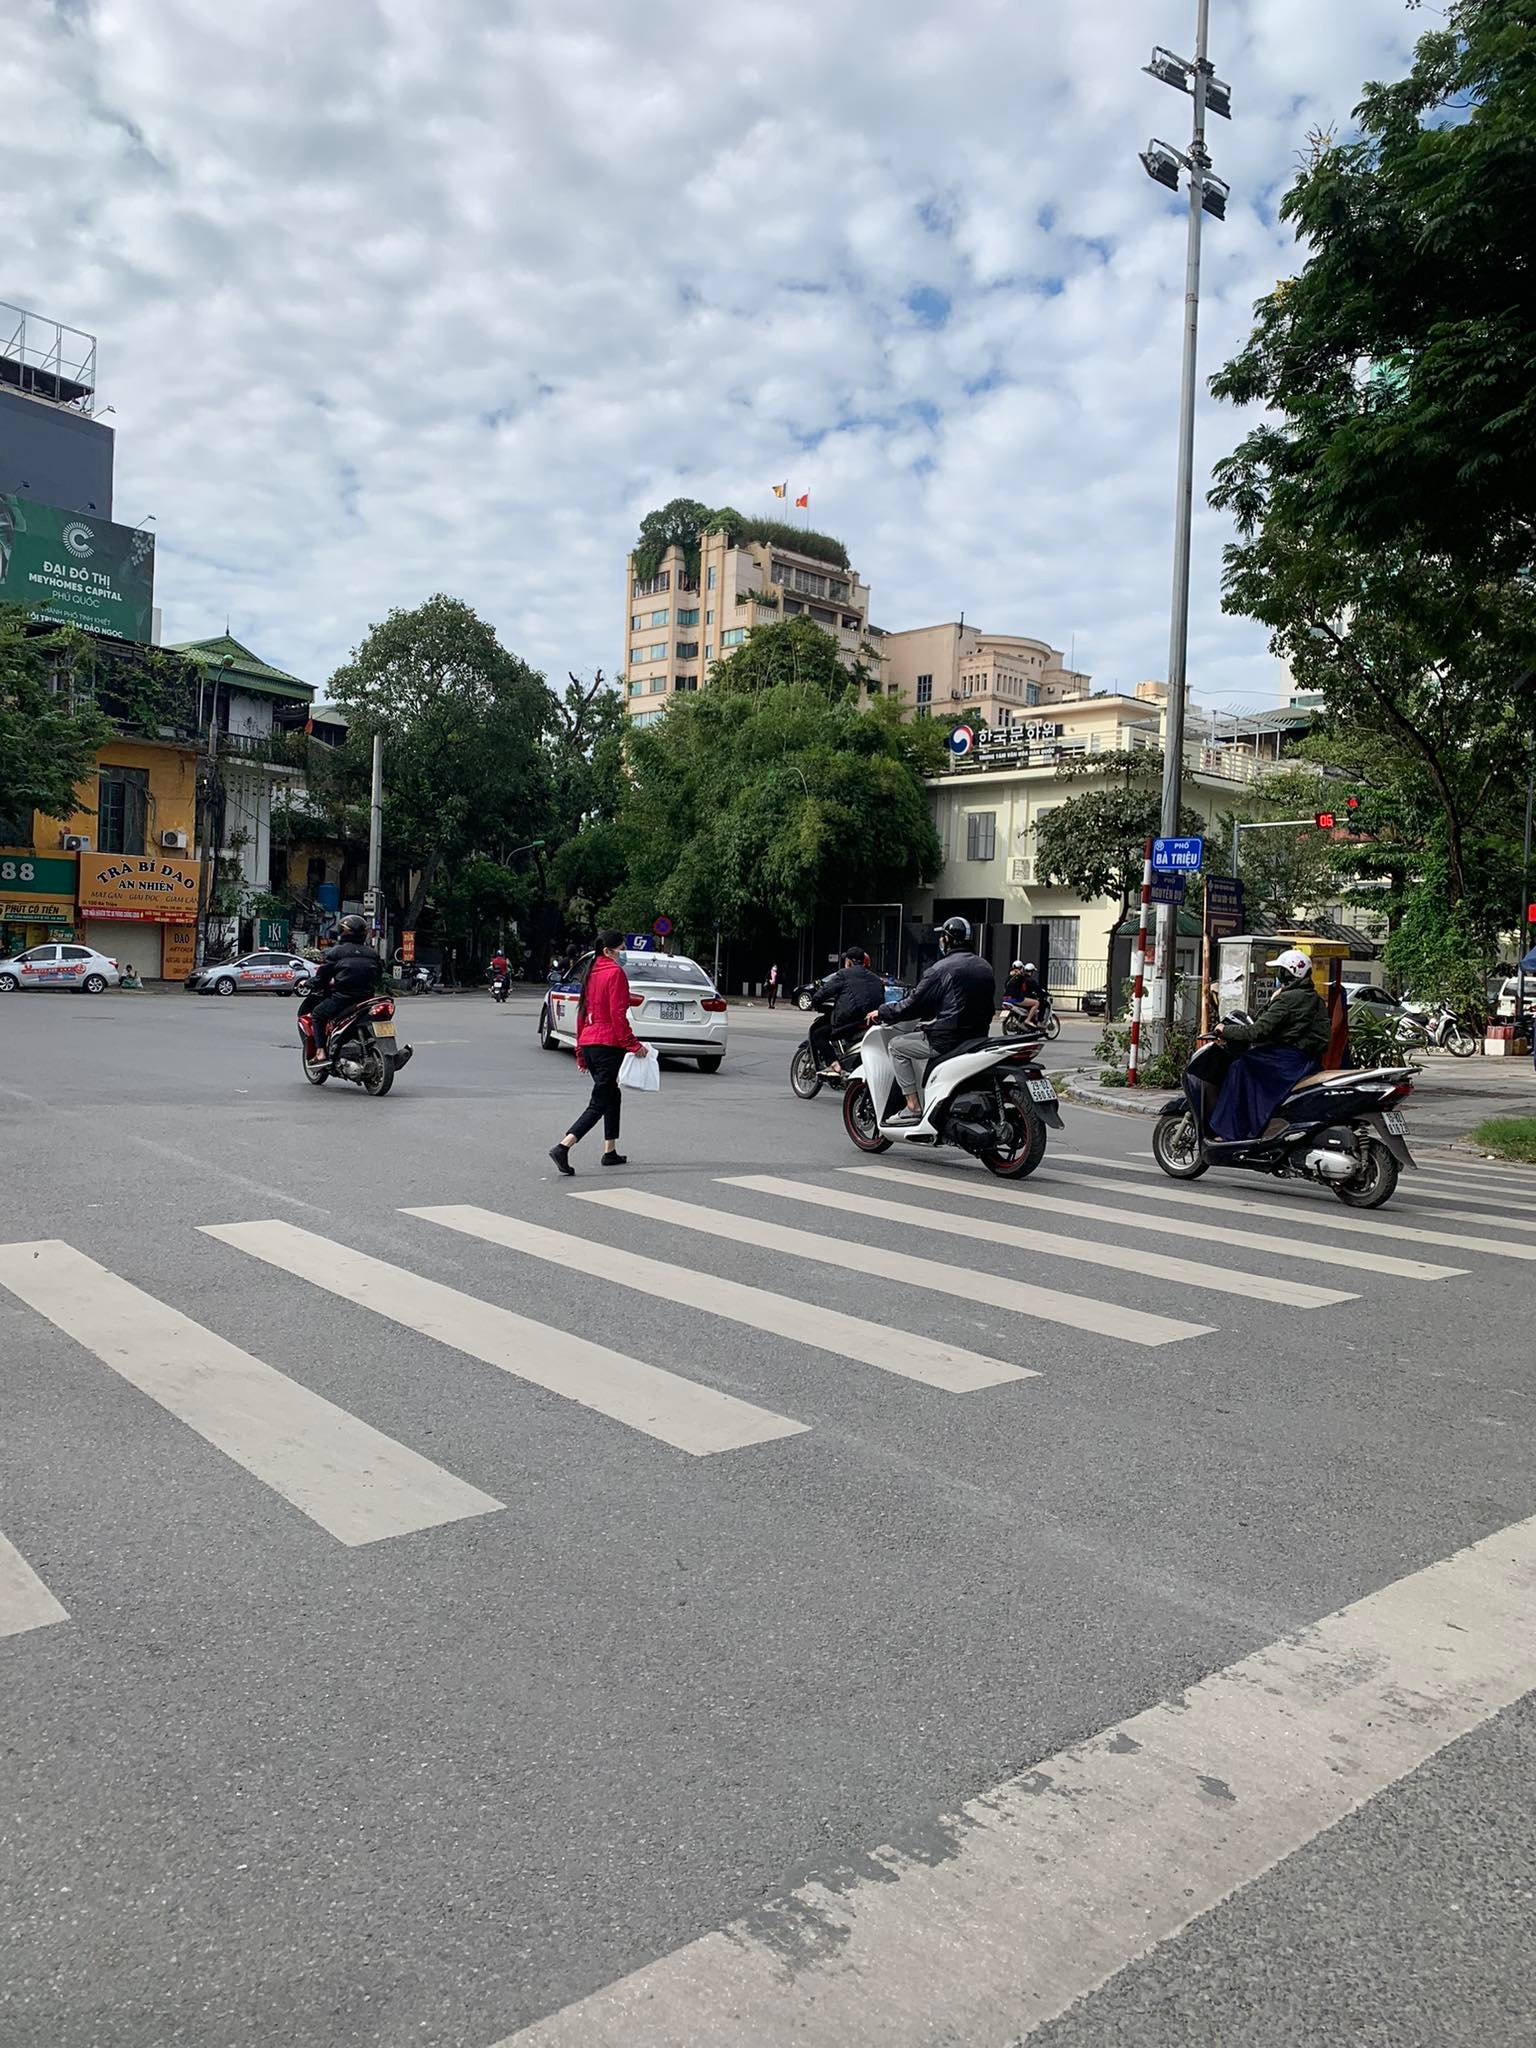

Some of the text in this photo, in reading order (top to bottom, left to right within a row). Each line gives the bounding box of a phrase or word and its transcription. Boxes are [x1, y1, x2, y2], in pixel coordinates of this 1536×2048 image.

[43, 561, 110, 589] ĐẠI ĐÔ THỊ
[29, 572, 122, 601] MEYHOMES CAPITAL
[52, 589, 71, 602] PHÚ
[978, 721, 1056, 748] 한국문화원
[1319, 814, 1333, 828] 06
[1174, 841, 1189, 849] PHỐ
[1156, 851, 1197, 867] BÀ TRIỆU
[96, 858, 195, 889] TRÀ BÍ ĐAO
[118, 880, 174, 892] AN NHIÊN
